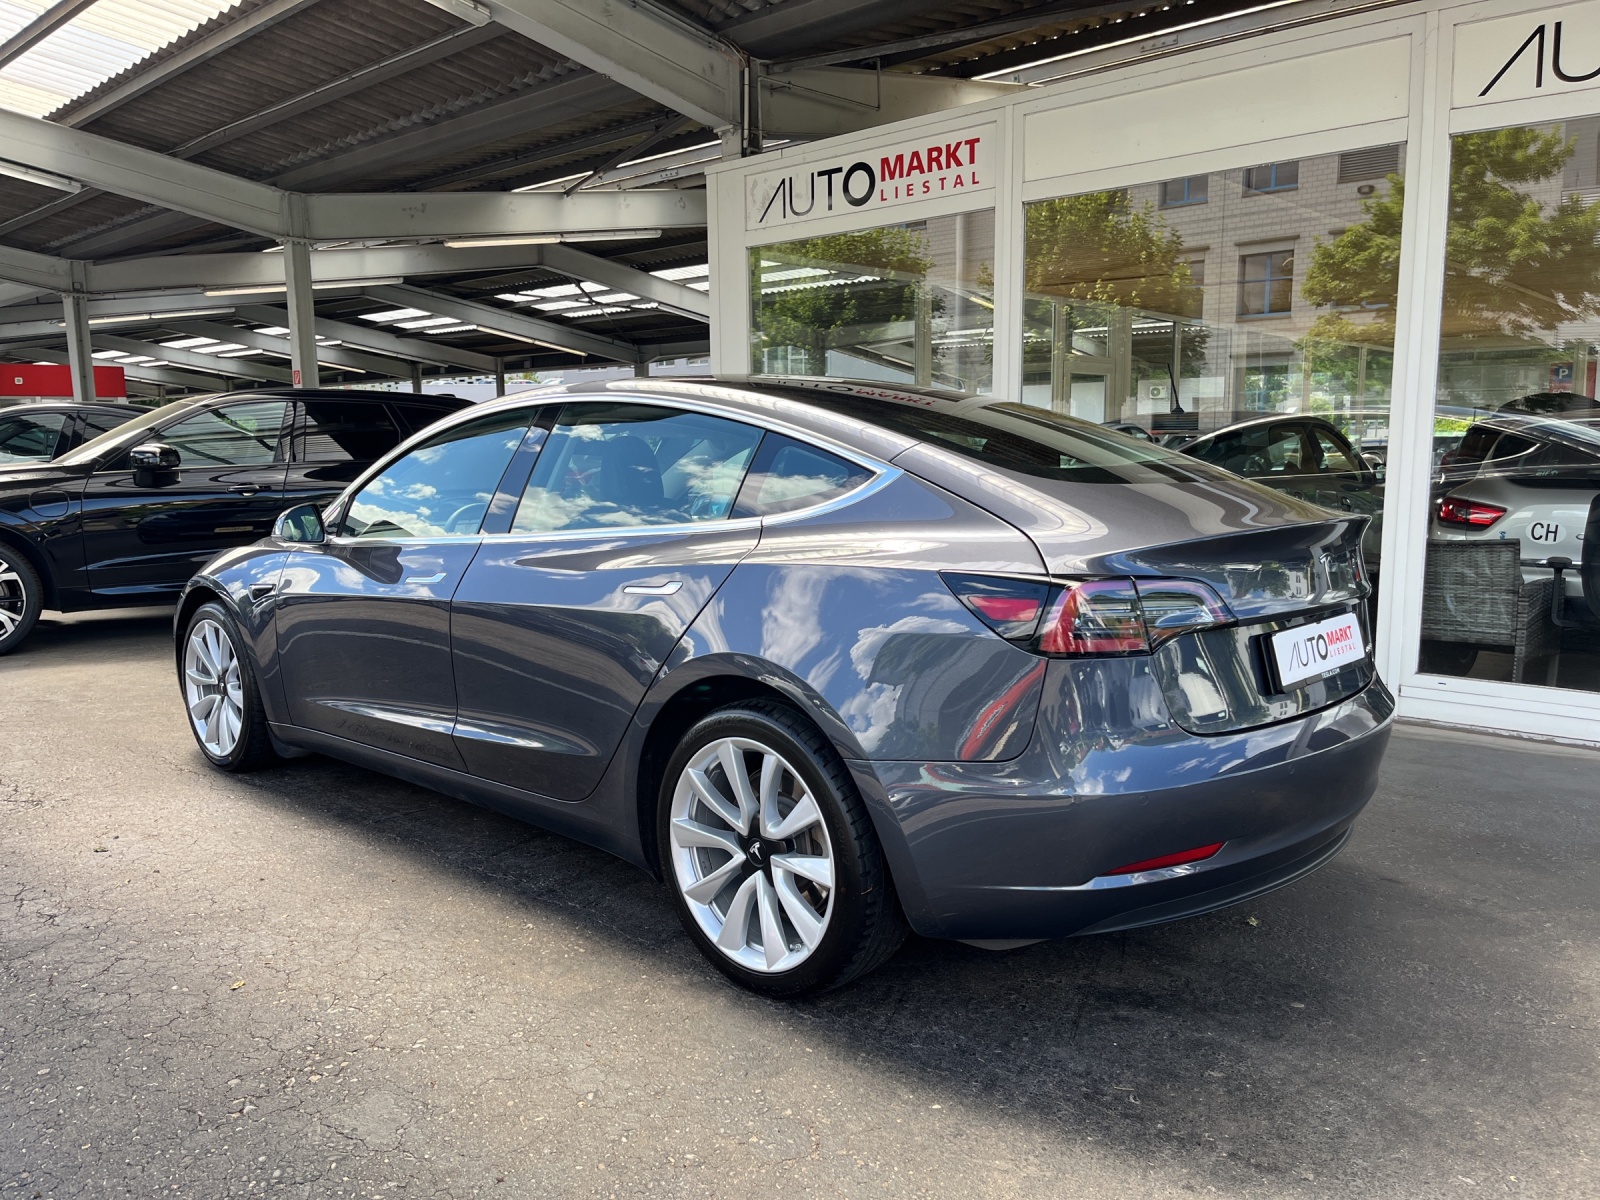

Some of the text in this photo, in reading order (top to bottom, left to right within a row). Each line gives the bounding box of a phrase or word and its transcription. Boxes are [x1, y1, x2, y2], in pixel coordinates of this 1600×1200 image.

[759, 137, 980, 223] AUTO MARKT
[880, 171, 980, 201] LIESTAL
[1559, 368, 1569, 379] P
[1531, 522, 1559, 542] CH
[1289, 625, 1353, 672] AUTO MARKT
[1329, 642, 1356, 658] LIESTAL
